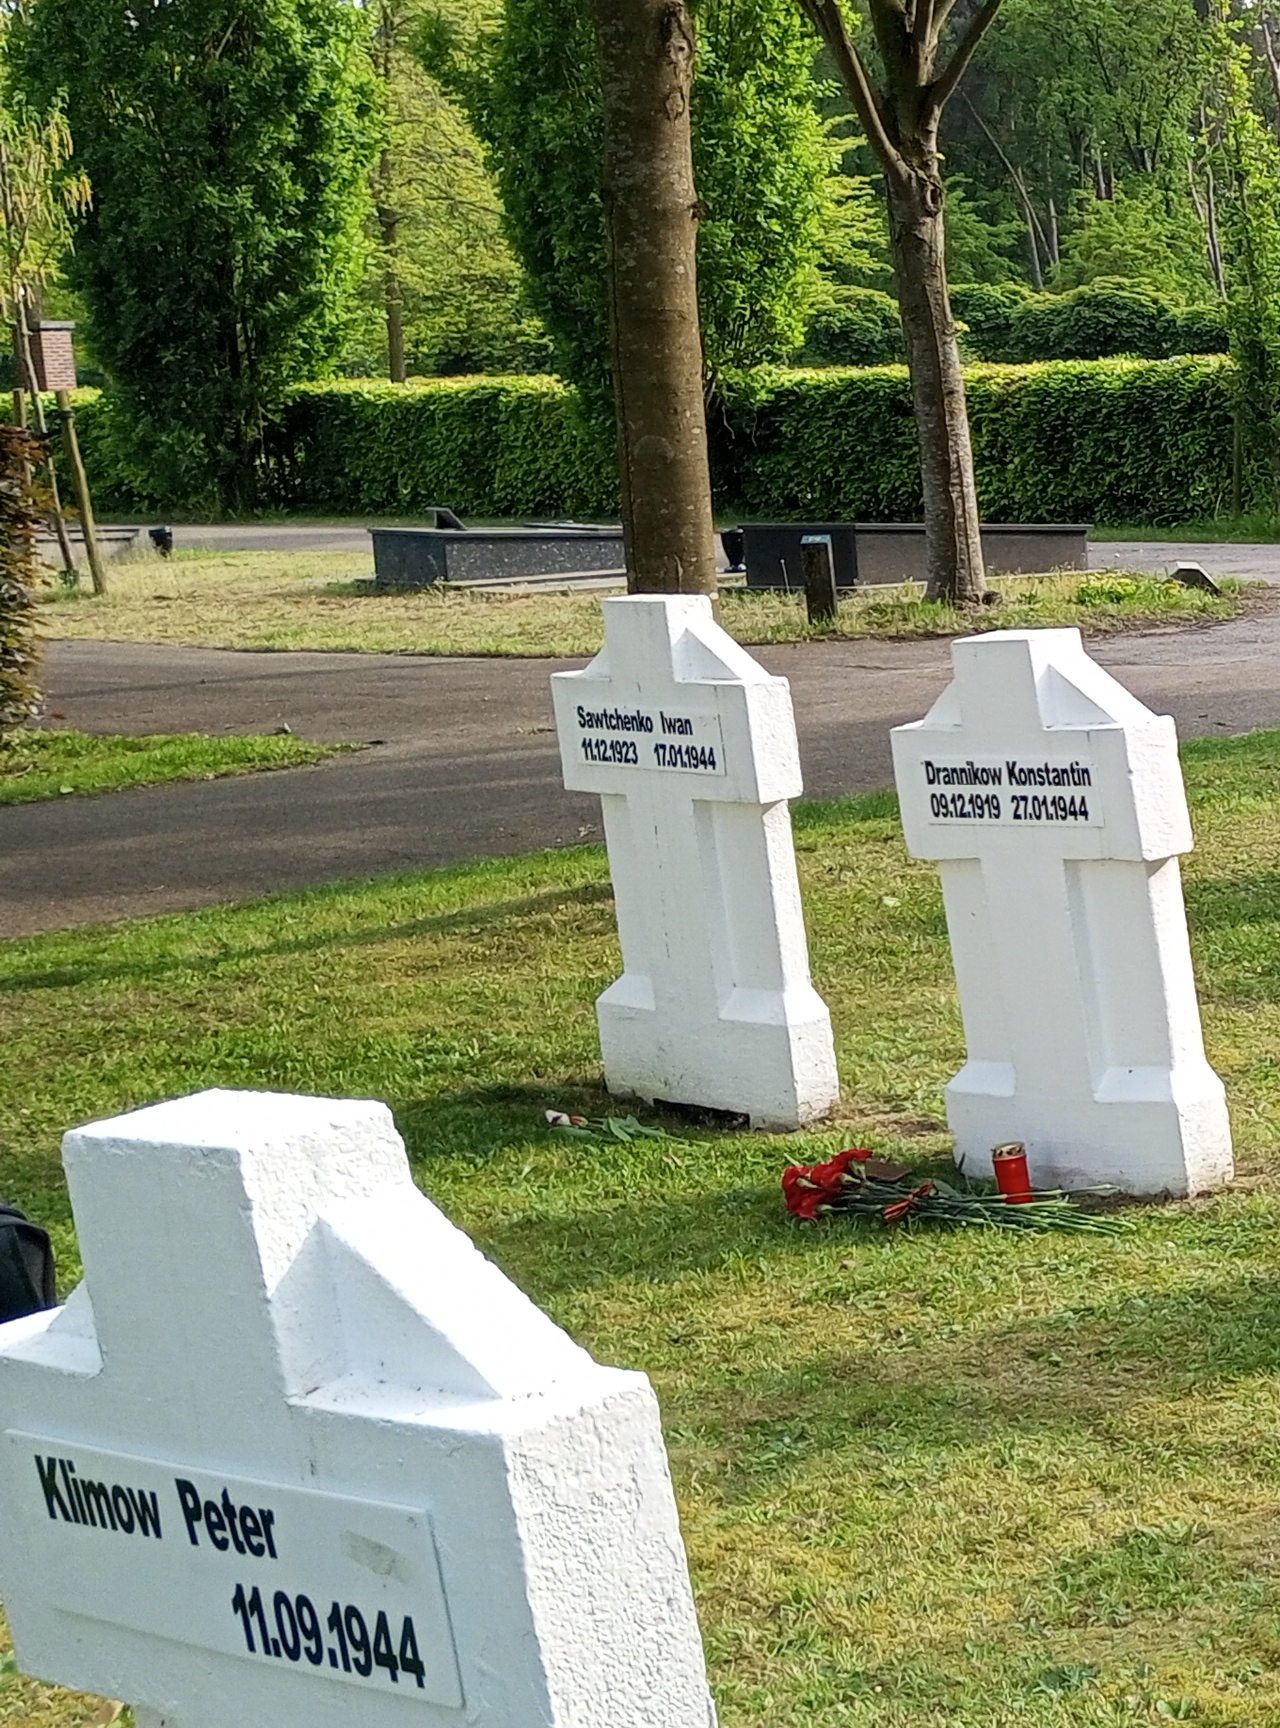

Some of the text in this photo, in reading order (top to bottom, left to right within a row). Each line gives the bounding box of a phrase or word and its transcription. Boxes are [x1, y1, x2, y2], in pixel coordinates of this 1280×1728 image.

[577, 705, 694, 736] Sawtchenko Iwan
[581, 737, 716, 771] 11.12.1923 17.01.1944
[924, 760, 1092, 787] Drannikow Konstantin
[930, 793, 1089, 821] 09.12.1919 27.01.1944
[34, 1454, 278, 1560] Klimow Peter
[231, 1582, 426, 1689] 11.09.1944
